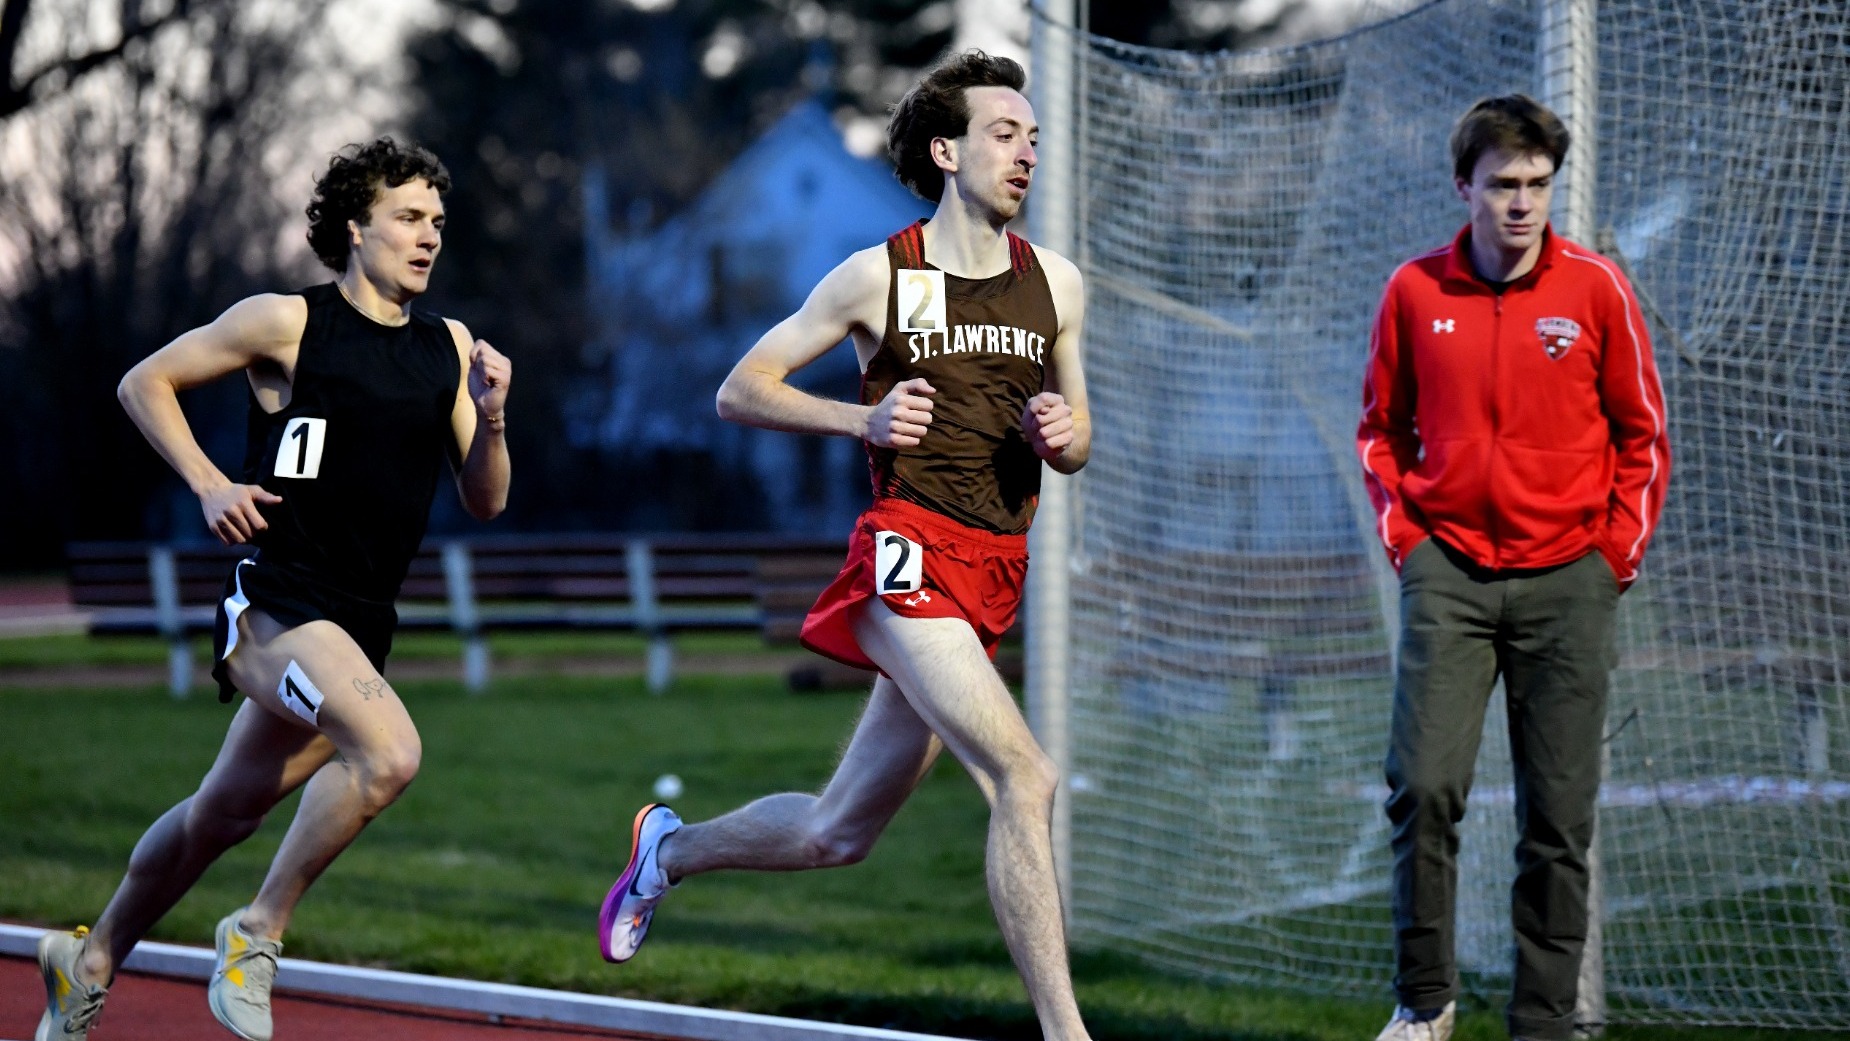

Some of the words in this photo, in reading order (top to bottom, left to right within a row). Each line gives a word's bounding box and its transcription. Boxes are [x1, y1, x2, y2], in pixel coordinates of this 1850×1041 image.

[908, 273, 935, 329] 2
[908, 332, 938, 363] ST.
[943, 324, 1046, 365] LAWRENCE
[291, 422, 309, 474] 1
[884, 535, 911, 590] 2
[285, 674, 316, 713] 1
